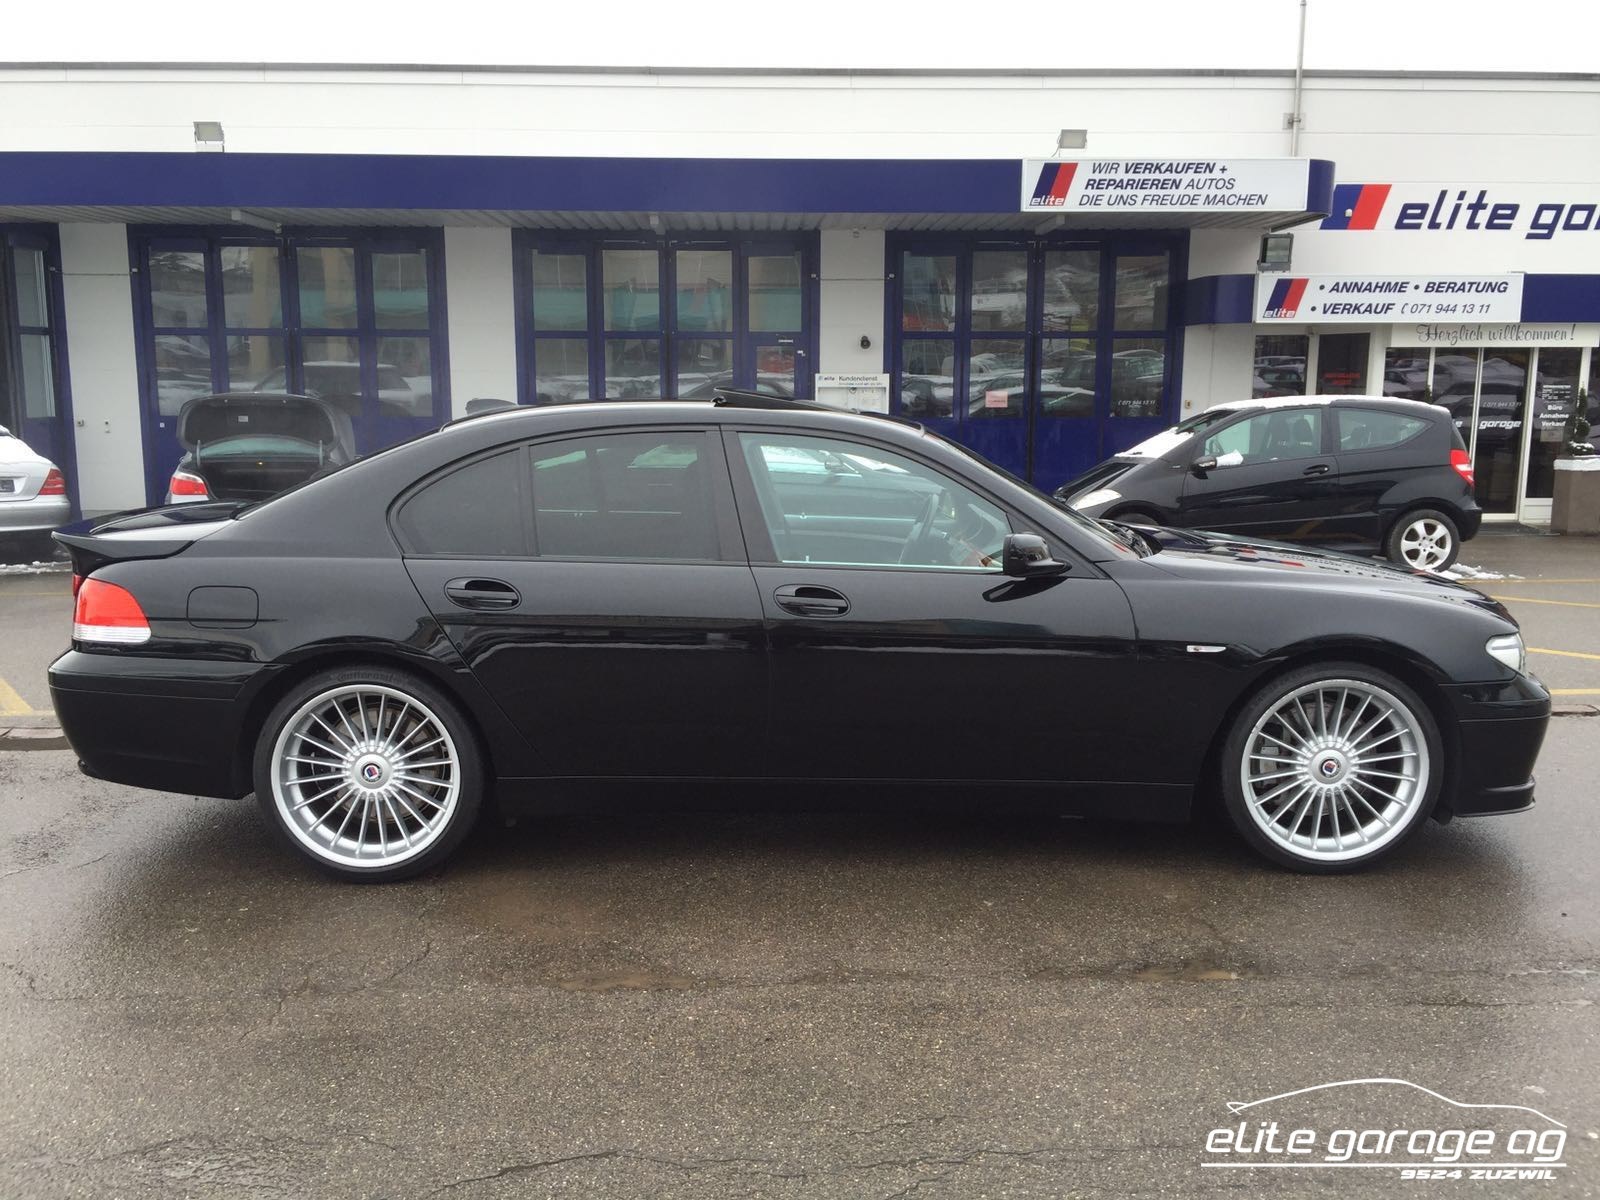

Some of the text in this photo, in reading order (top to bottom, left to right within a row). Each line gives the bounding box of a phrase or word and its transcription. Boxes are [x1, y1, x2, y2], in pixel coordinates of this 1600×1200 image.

[1091, 162, 1120, 175] WIR
[1124, 162, 1216, 175] VERKAUFEN
[1084, 178, 1236, 190] REPARIEREN AUTOS
[1029, 195, 1065, 207] elite
[1078, 194, 1268, 206] DIE UNS FREUDE MACHEN
[1394, 189, 1600, 240] elite ga
[1328, 281, 1509, 293] ANNAHME BERATUNG
[1263, 308, 1296, 318] elite
[1322, 303, 1491, 315] VERKAUF 071 944 13 11
[1416, 323, 1576, 346] Herzlich willkommen!
[1479, 420, 1522, 430] garage
